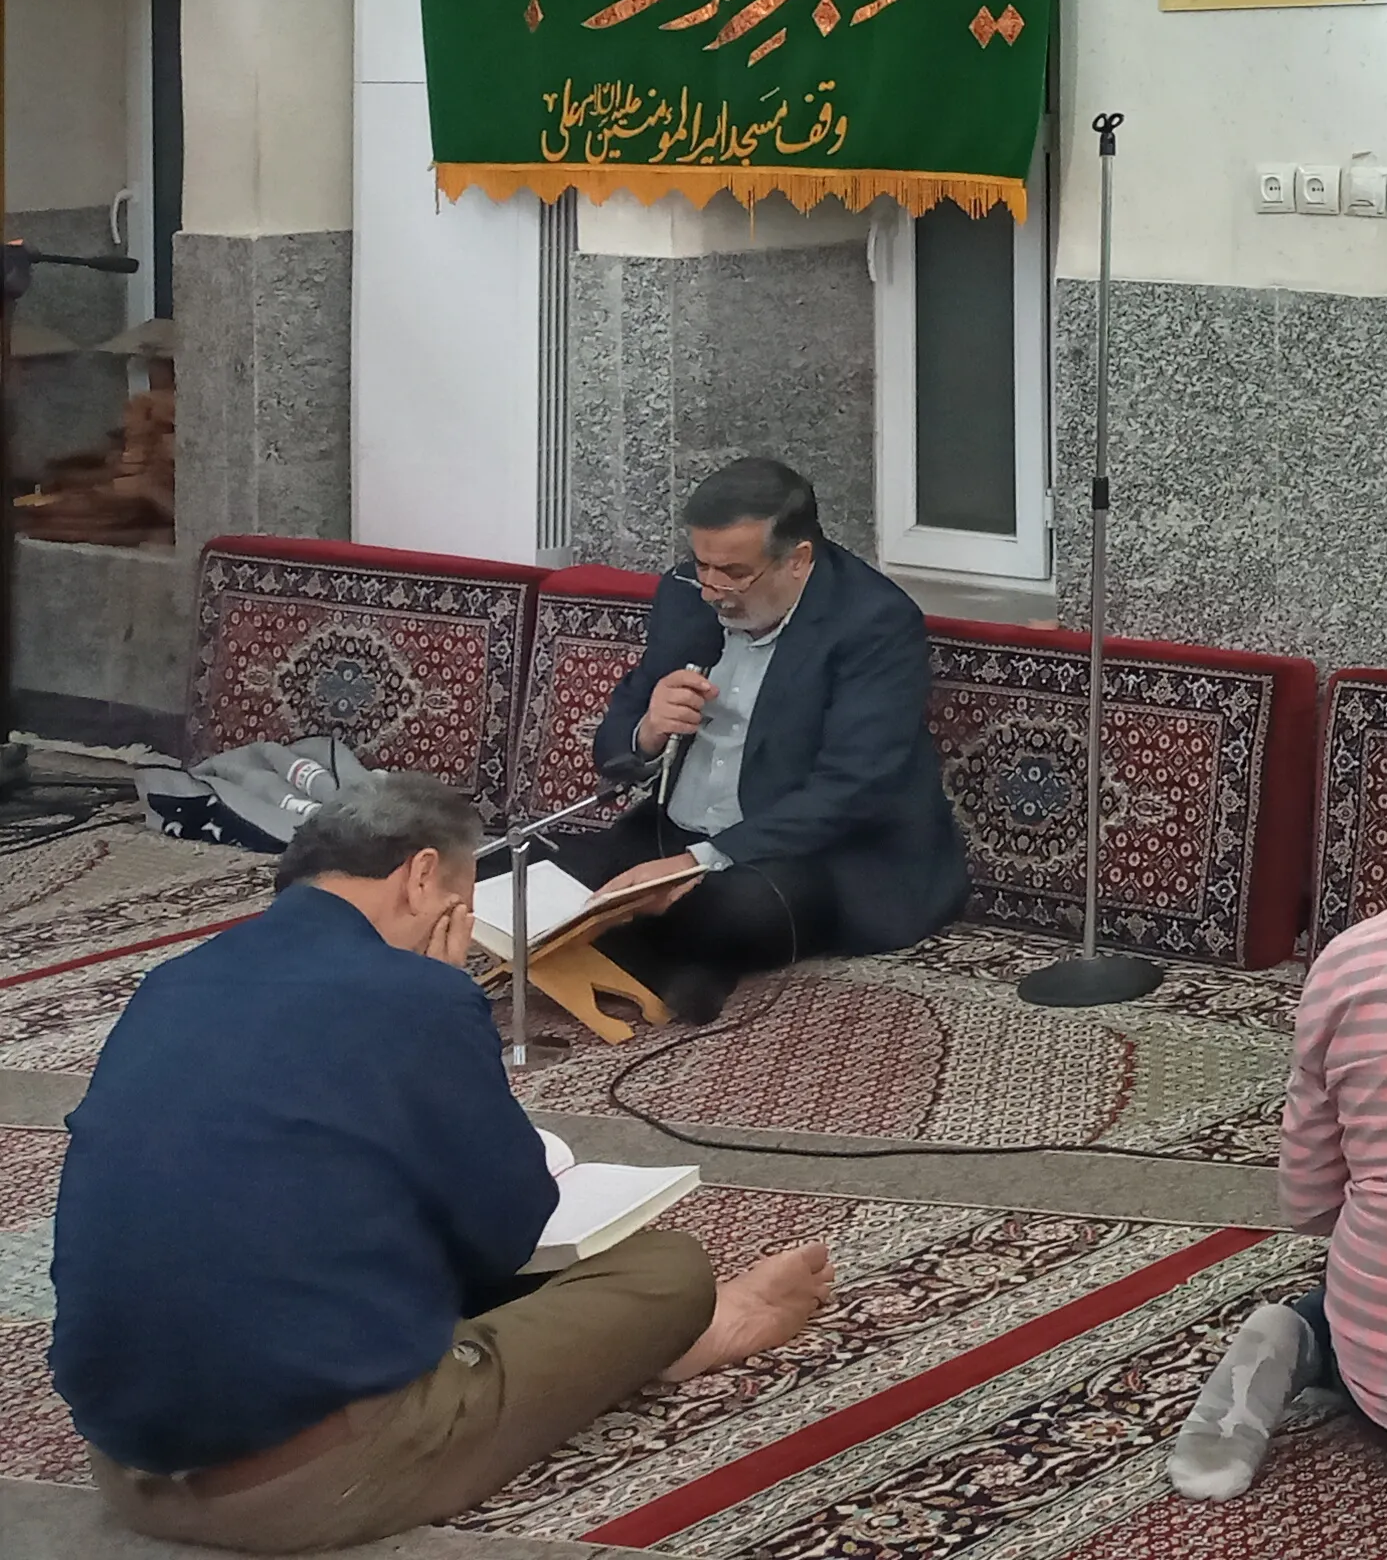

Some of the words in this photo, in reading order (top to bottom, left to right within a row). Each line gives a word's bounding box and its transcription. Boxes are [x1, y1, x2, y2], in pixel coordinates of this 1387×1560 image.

[541, 78, 580, 162] علی
[720, 99, 789, 166] مسجد
[775, 80, 848, 155] وقف
